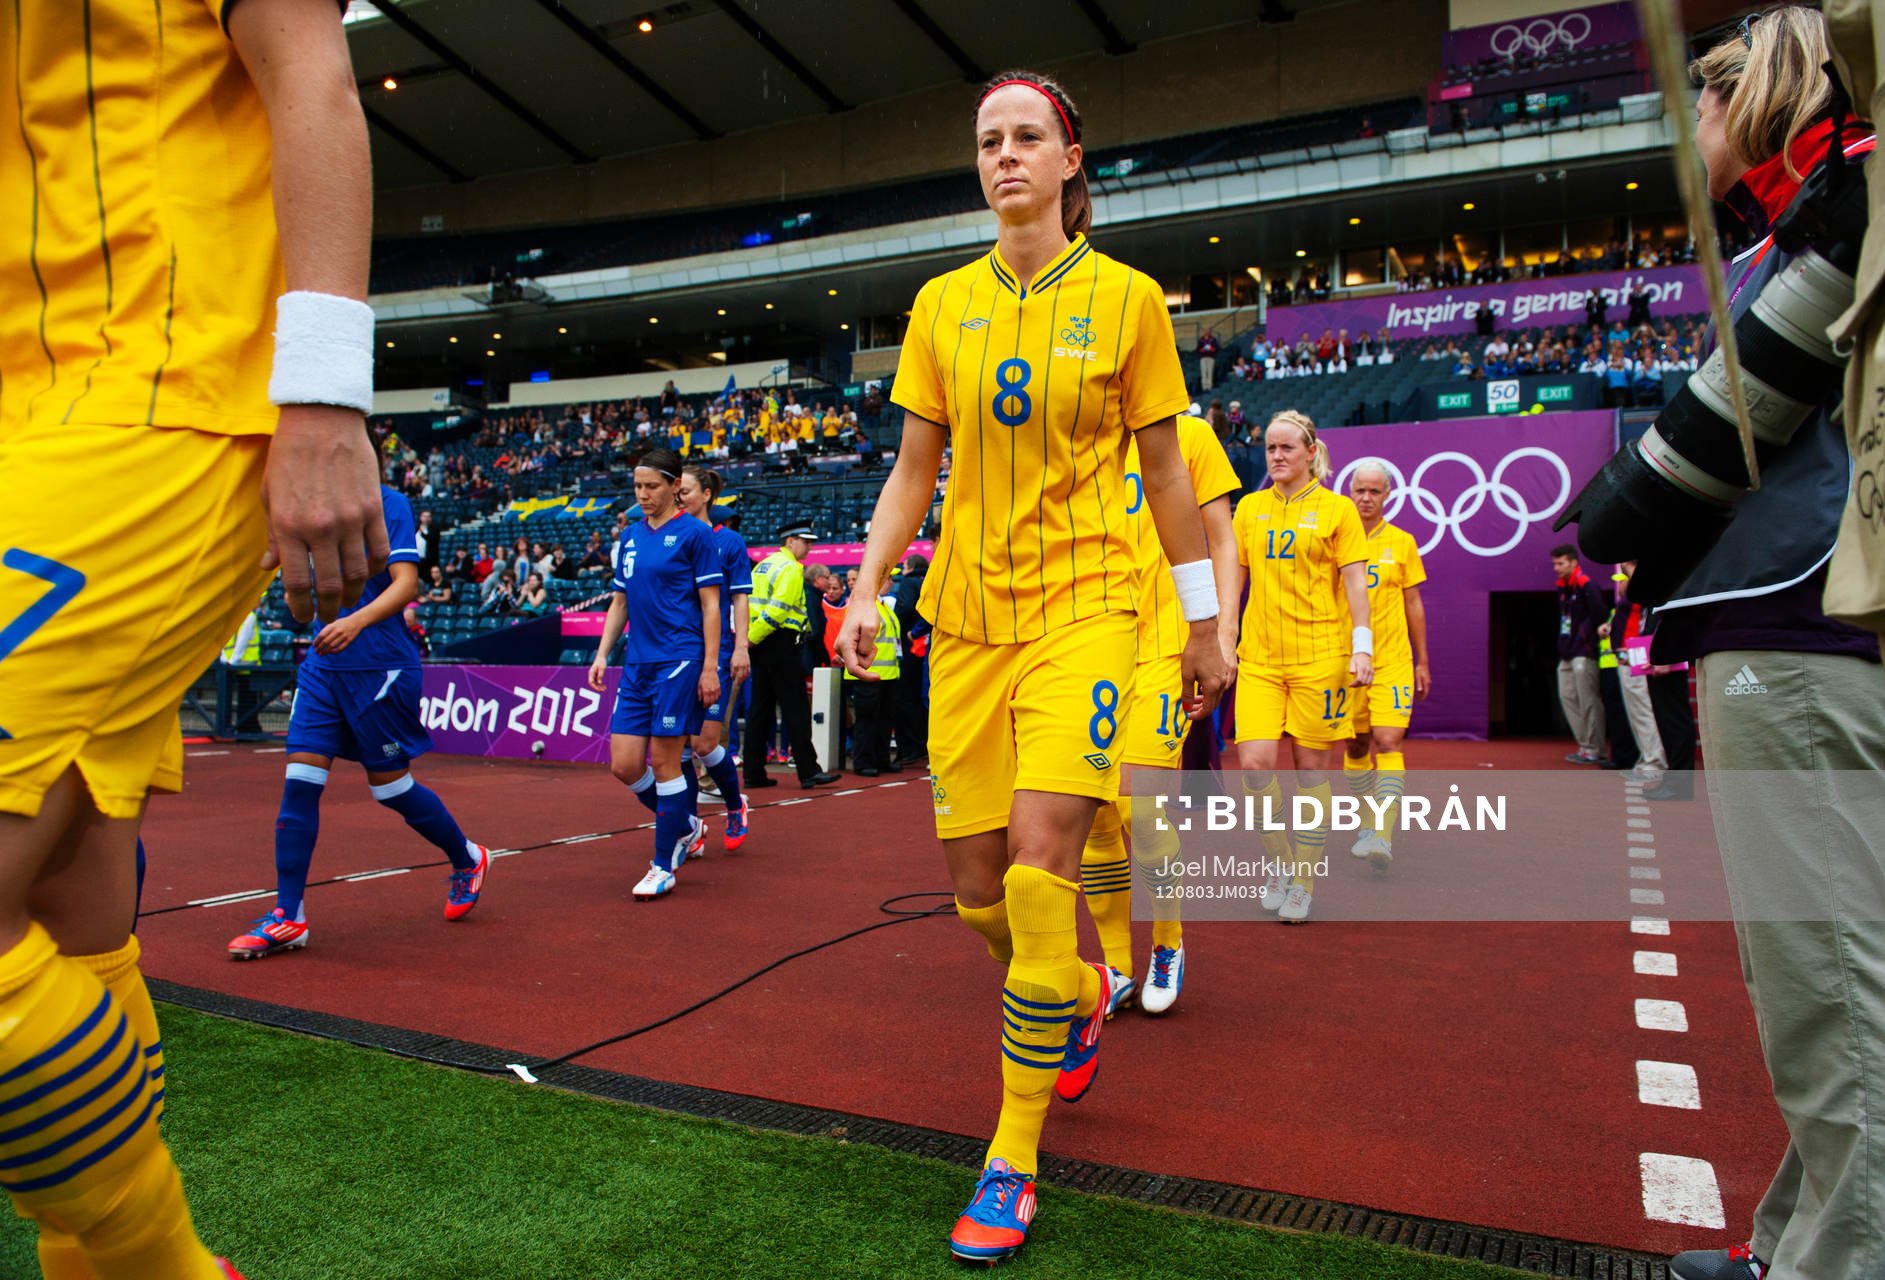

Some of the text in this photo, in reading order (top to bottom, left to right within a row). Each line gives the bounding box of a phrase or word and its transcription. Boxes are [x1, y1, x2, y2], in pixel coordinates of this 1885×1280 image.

[1386, 294, 1481, 331] Inspire
[1488, 298, 1507, 317] a
[1512, 276, 1684, 323] geneaton
[1054, 347, 1097, 361] SWE
[992, 357, 1032, 427] 8
[1440, 394, 1470, 407] EXIT
[1490, 383, 1518, 400] 50
[1540, 387, 1571, 400] EXIT
[1265, 529, 1296, 559] 12
[623, 551, 637, 579] 5
[1322, 687, 1346, 720] 12
[1392, 686, 1412, 709] 15
[1724, 682, 1768, 696] adidas
[419, 682, 601, 738] ndon 2012
[1089, 679, 1119, 750] 8
[1156, 693, 1189, 738] 10
